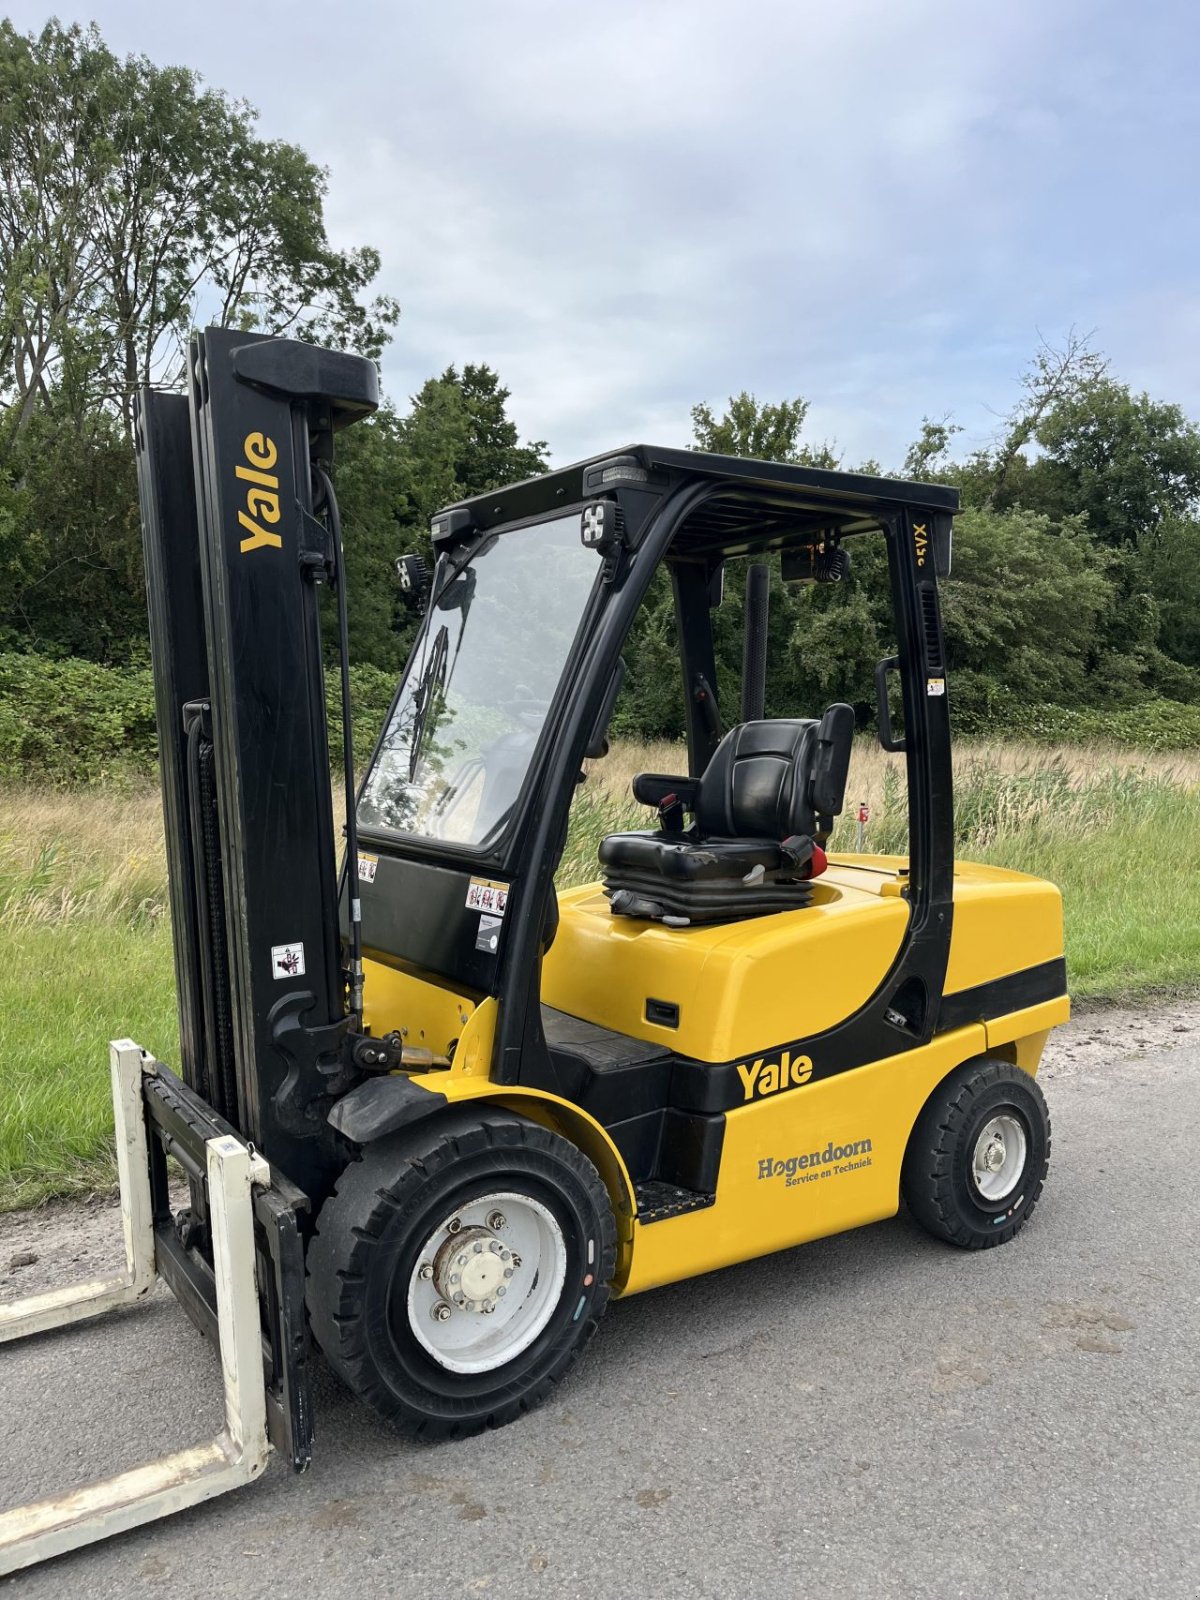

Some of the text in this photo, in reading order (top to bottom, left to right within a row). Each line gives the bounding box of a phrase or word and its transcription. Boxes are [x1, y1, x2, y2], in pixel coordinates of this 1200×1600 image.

[235, 431, 283, 553] Yale
[736, 1051, 813, 1100] Yale
[757, 1138, 872, 1179] Hogendoorn
[785, 1157, 872, 1187] Service en Techniek
